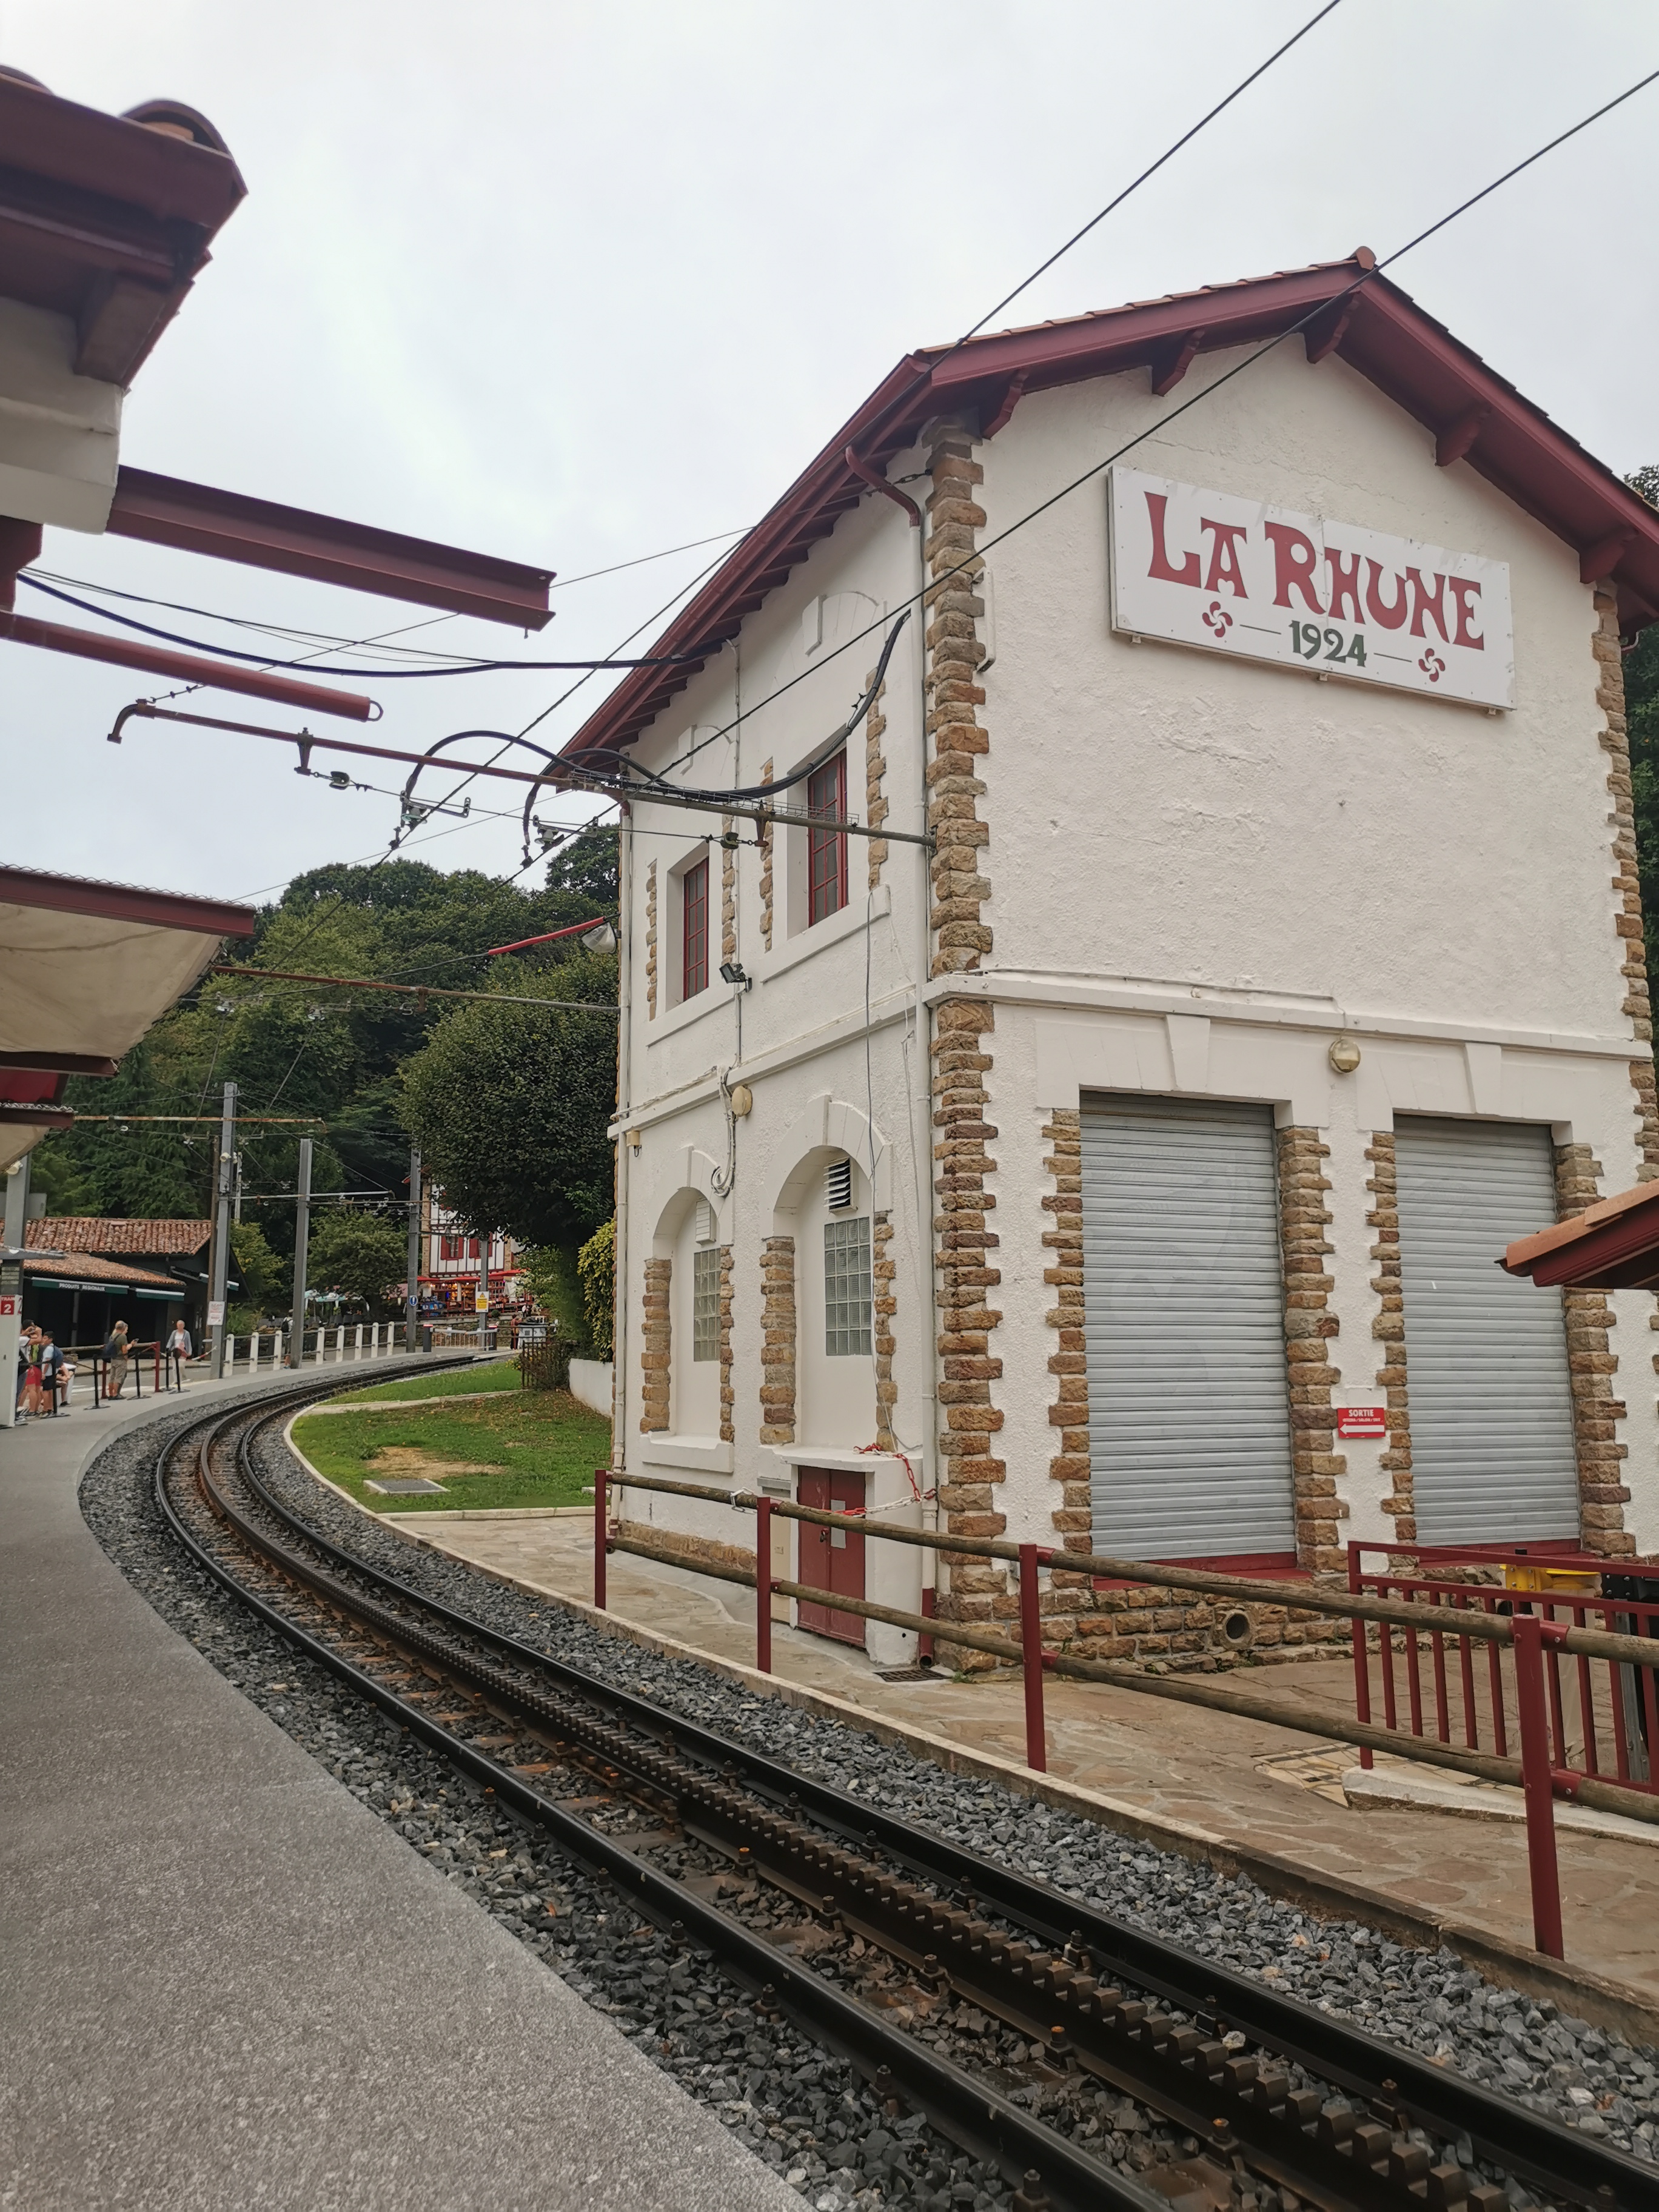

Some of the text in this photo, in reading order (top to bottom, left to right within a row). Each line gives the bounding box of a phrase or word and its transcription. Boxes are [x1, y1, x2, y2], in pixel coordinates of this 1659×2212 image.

[1144, 491, 1484, 651] LA RHUNE
[1288, 620, 1367, 667] 1924
[4, 1304, 12, 1313] 2
